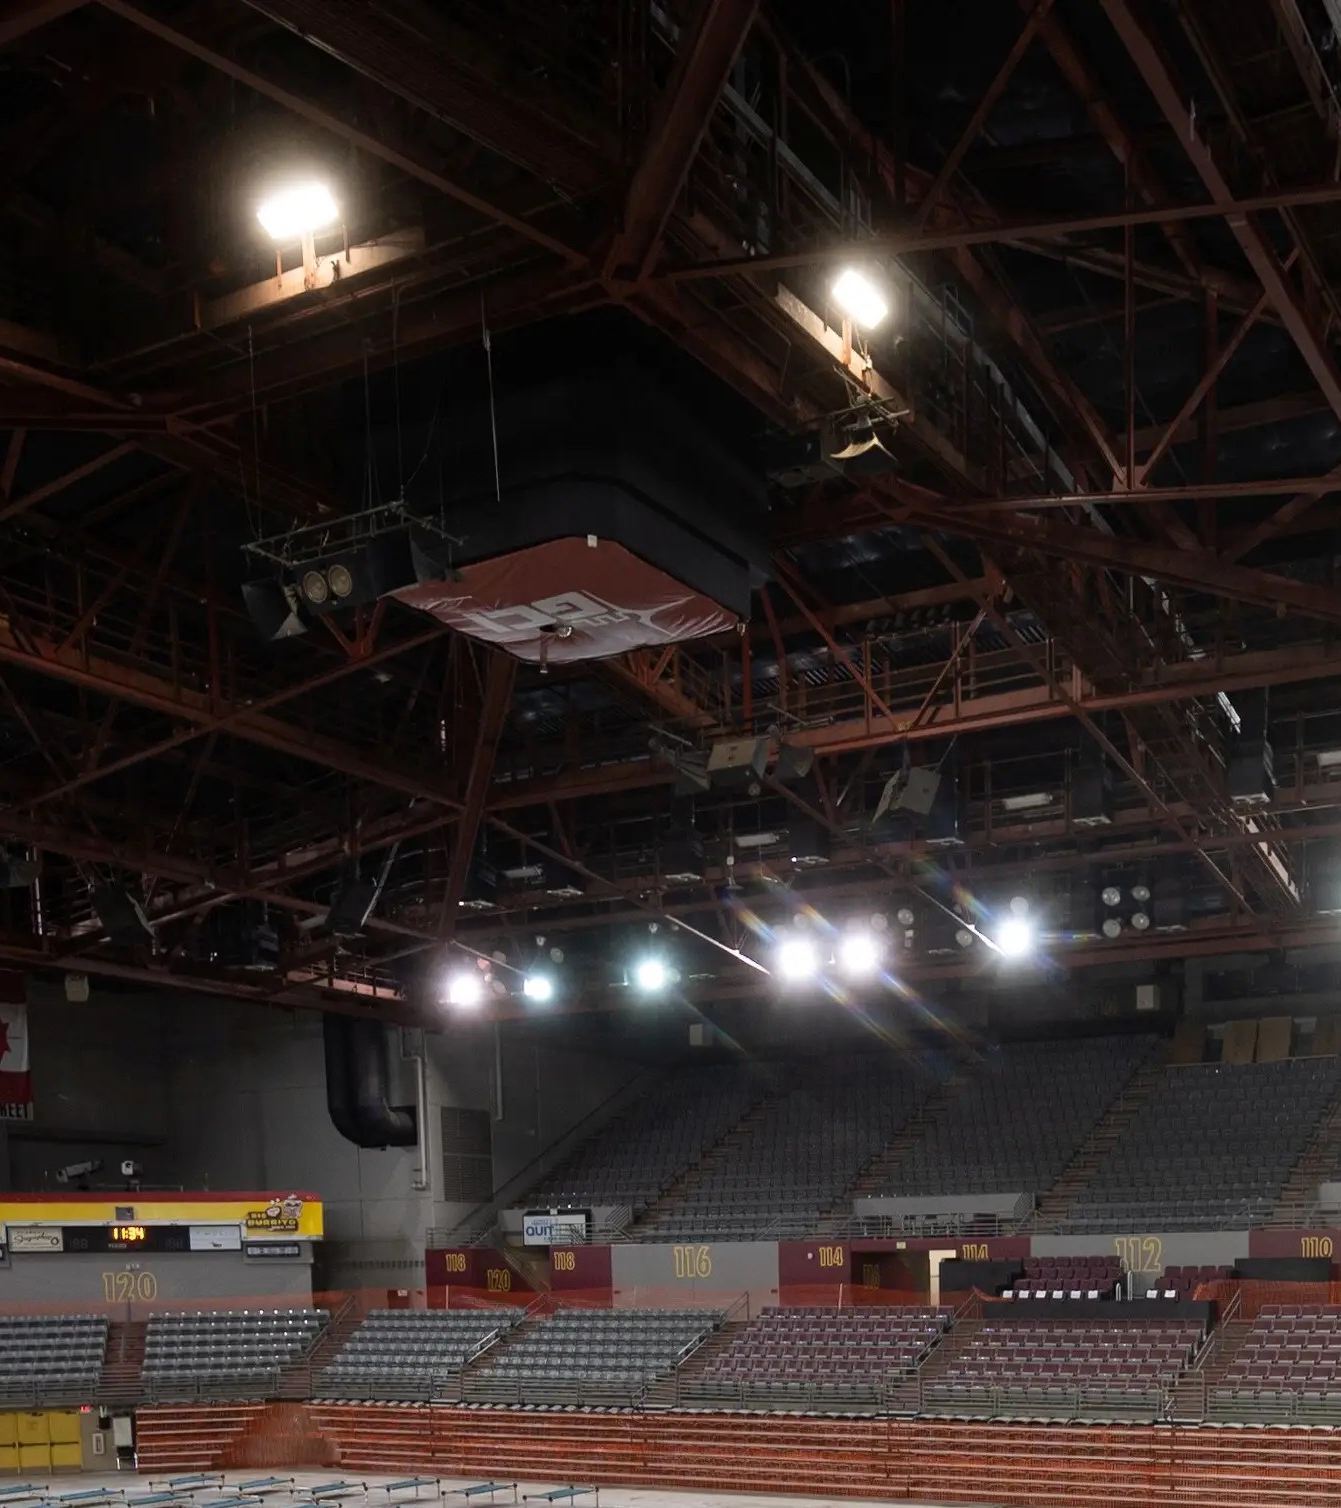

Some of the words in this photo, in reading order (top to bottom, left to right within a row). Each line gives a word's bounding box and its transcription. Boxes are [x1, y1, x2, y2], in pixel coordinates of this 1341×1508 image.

[113, 1226, 145, 1241] 11:34
[818, 1246, 844, 1267] 114
[1115, 1236, 1161, 1273] 112
[1300, 1237, 1334, 1258] 110
[445, 1253, 467, 1272] 118
[553, 1251, 576, 1270] 118
[673, 1245, 712, 1278] 116
[102, 1272, 158, 1303] 120
